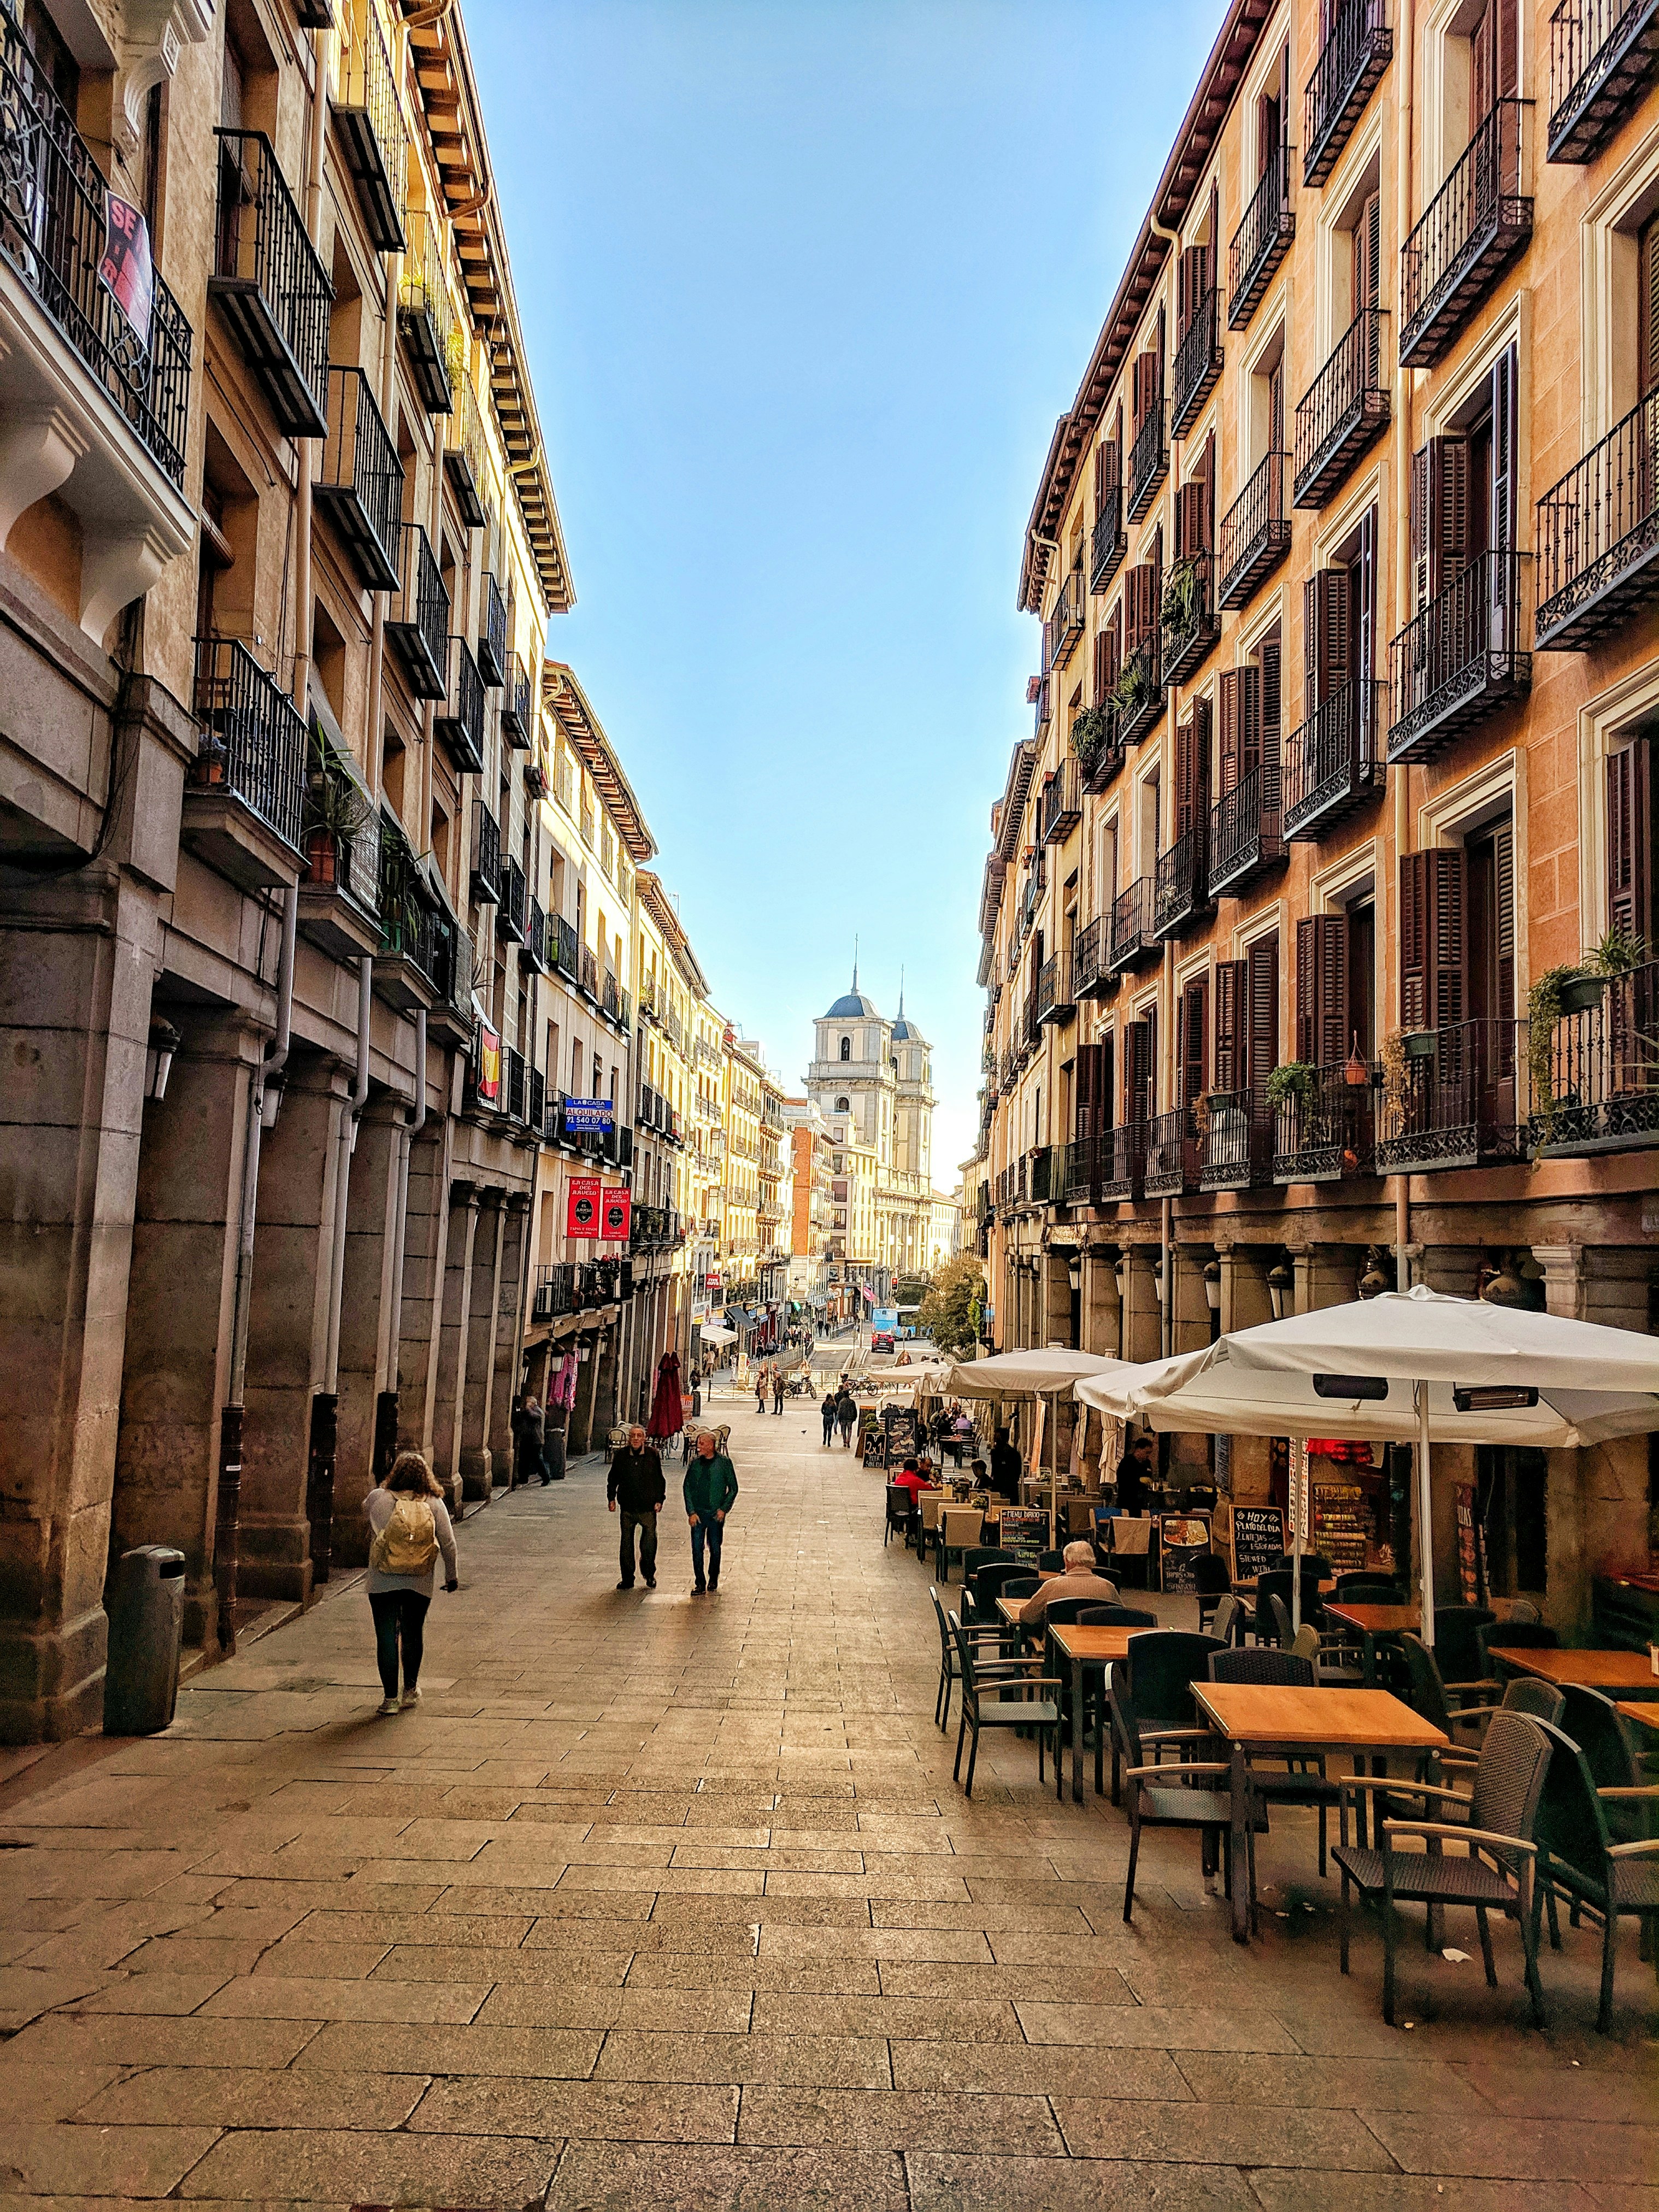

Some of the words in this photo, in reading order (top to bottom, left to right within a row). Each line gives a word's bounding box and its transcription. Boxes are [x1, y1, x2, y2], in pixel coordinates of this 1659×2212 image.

[111, 199, 137, 240] SE
[567, 1108, 612, 1117] ALQUILADO
[1247, 1511, 1268, 1523] HOY
[1235, 1521, 1256, 1531] PLATO
